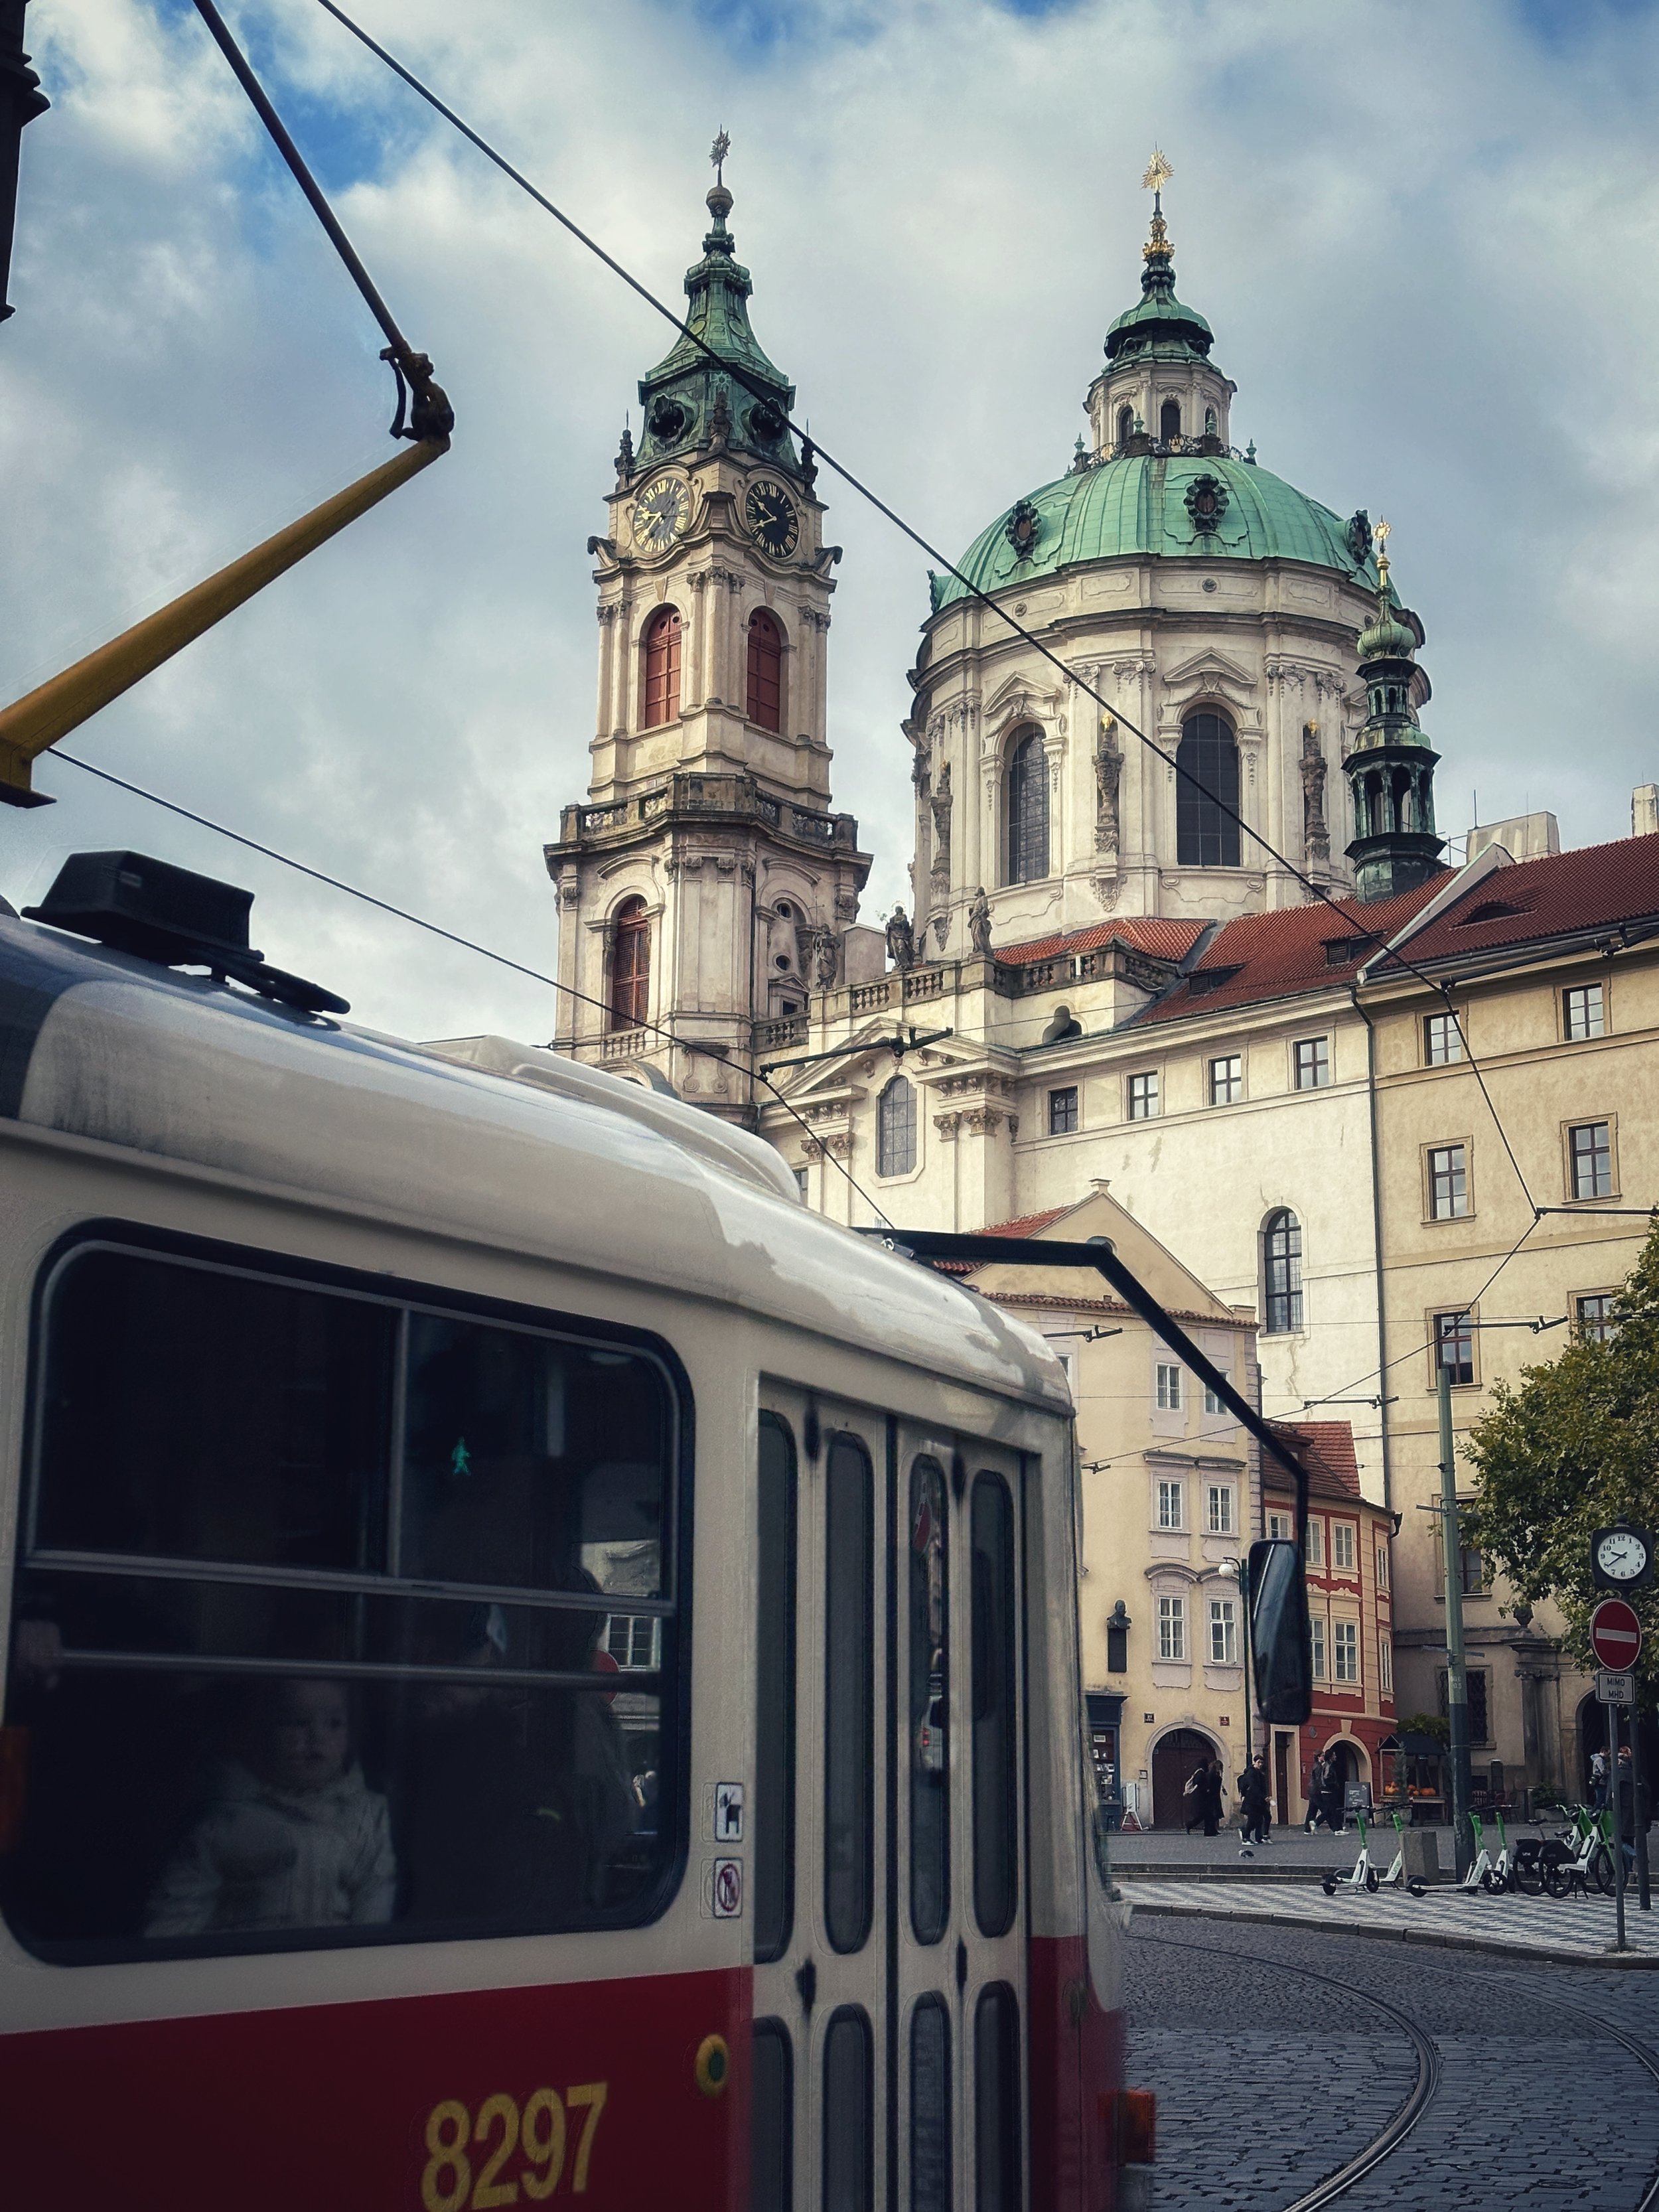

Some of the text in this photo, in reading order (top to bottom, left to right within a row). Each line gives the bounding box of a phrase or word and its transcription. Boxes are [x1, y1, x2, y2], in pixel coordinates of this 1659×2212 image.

[1607, 1677, 1625, 1686] MIMO
[1609, 1690, 1624, 1699] MHD
[421, 2081, 609, 2212] 8297
